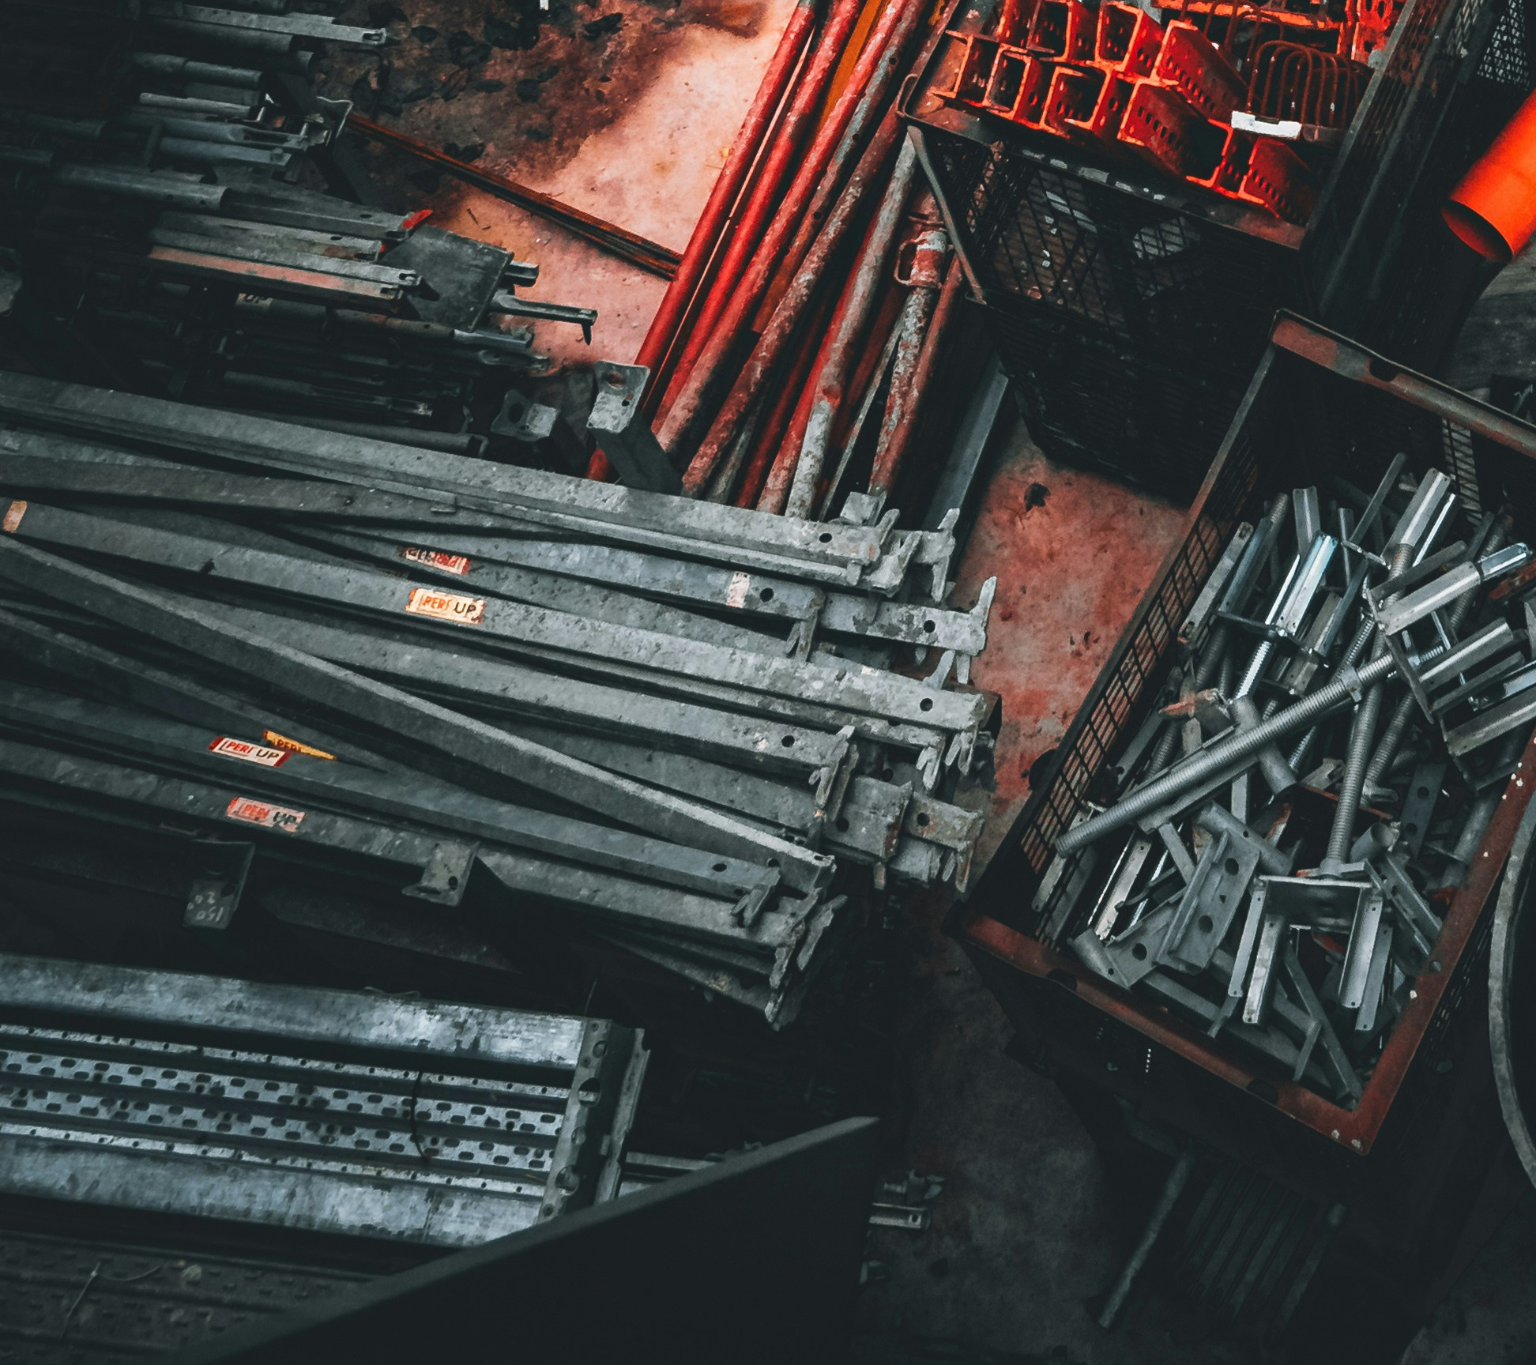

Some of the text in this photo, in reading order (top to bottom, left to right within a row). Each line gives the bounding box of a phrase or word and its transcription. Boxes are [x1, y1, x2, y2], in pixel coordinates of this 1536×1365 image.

[454, 602, 478, 618] UP
[226, 740, 280, 760] PERI UP
[241, 804, 271, 820] PERI
